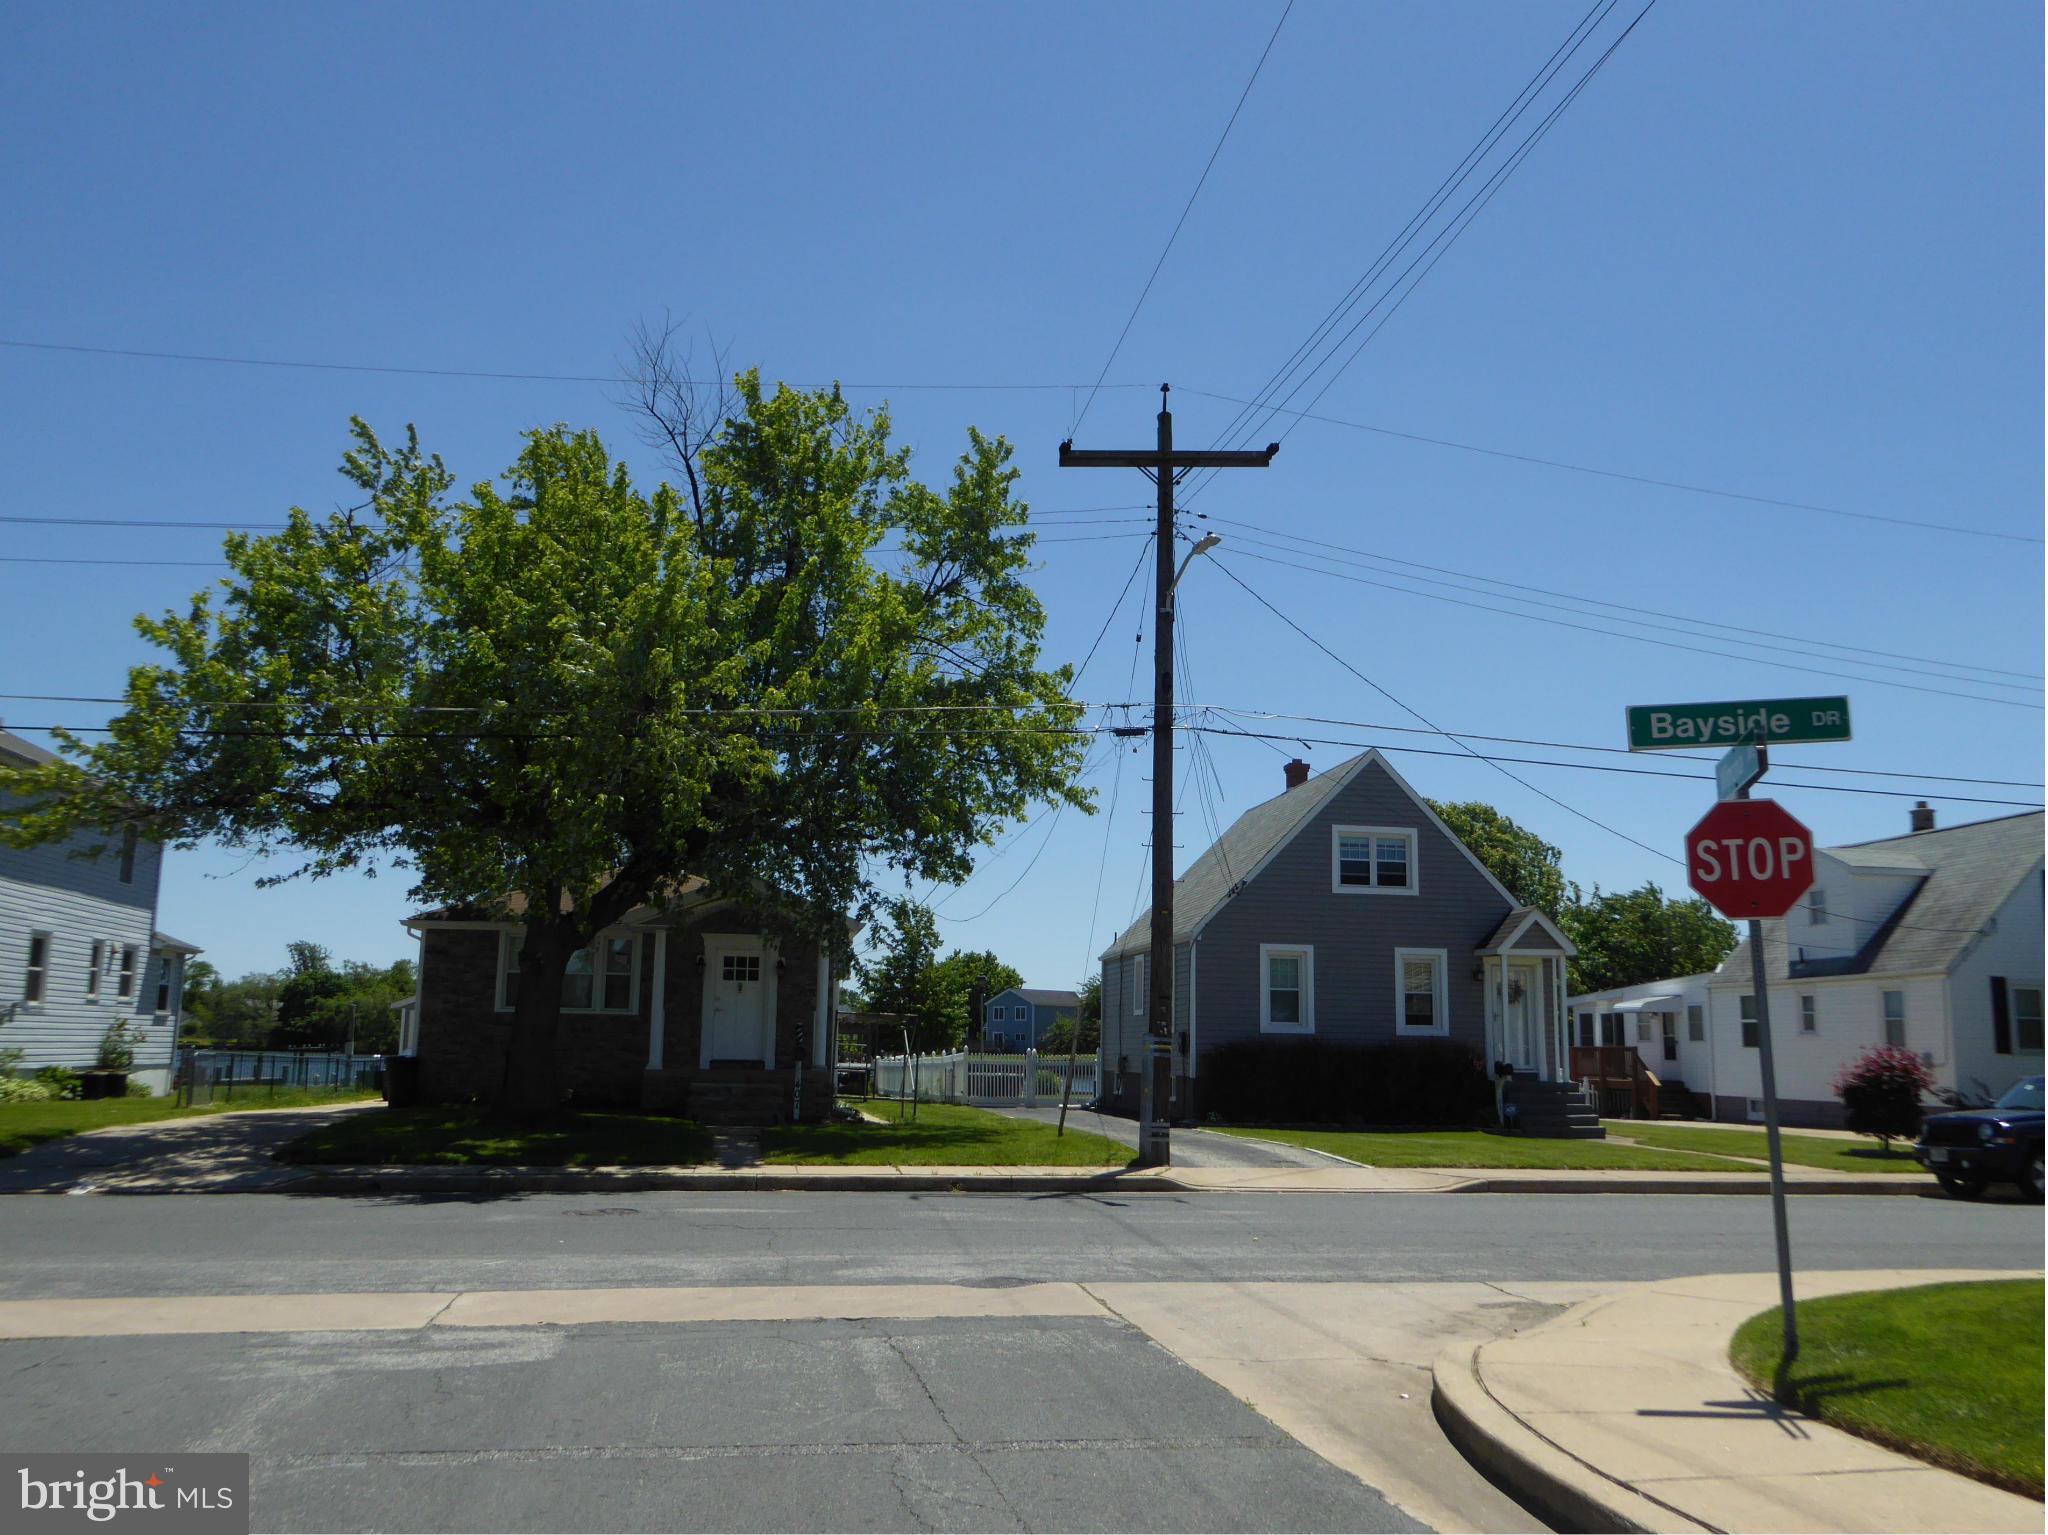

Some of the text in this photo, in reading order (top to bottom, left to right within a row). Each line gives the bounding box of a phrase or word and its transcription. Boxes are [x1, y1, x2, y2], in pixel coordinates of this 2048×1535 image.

[1650, 707, 1842, 742] Bayside DR
[1696, 836, 1805, 882] STOP
